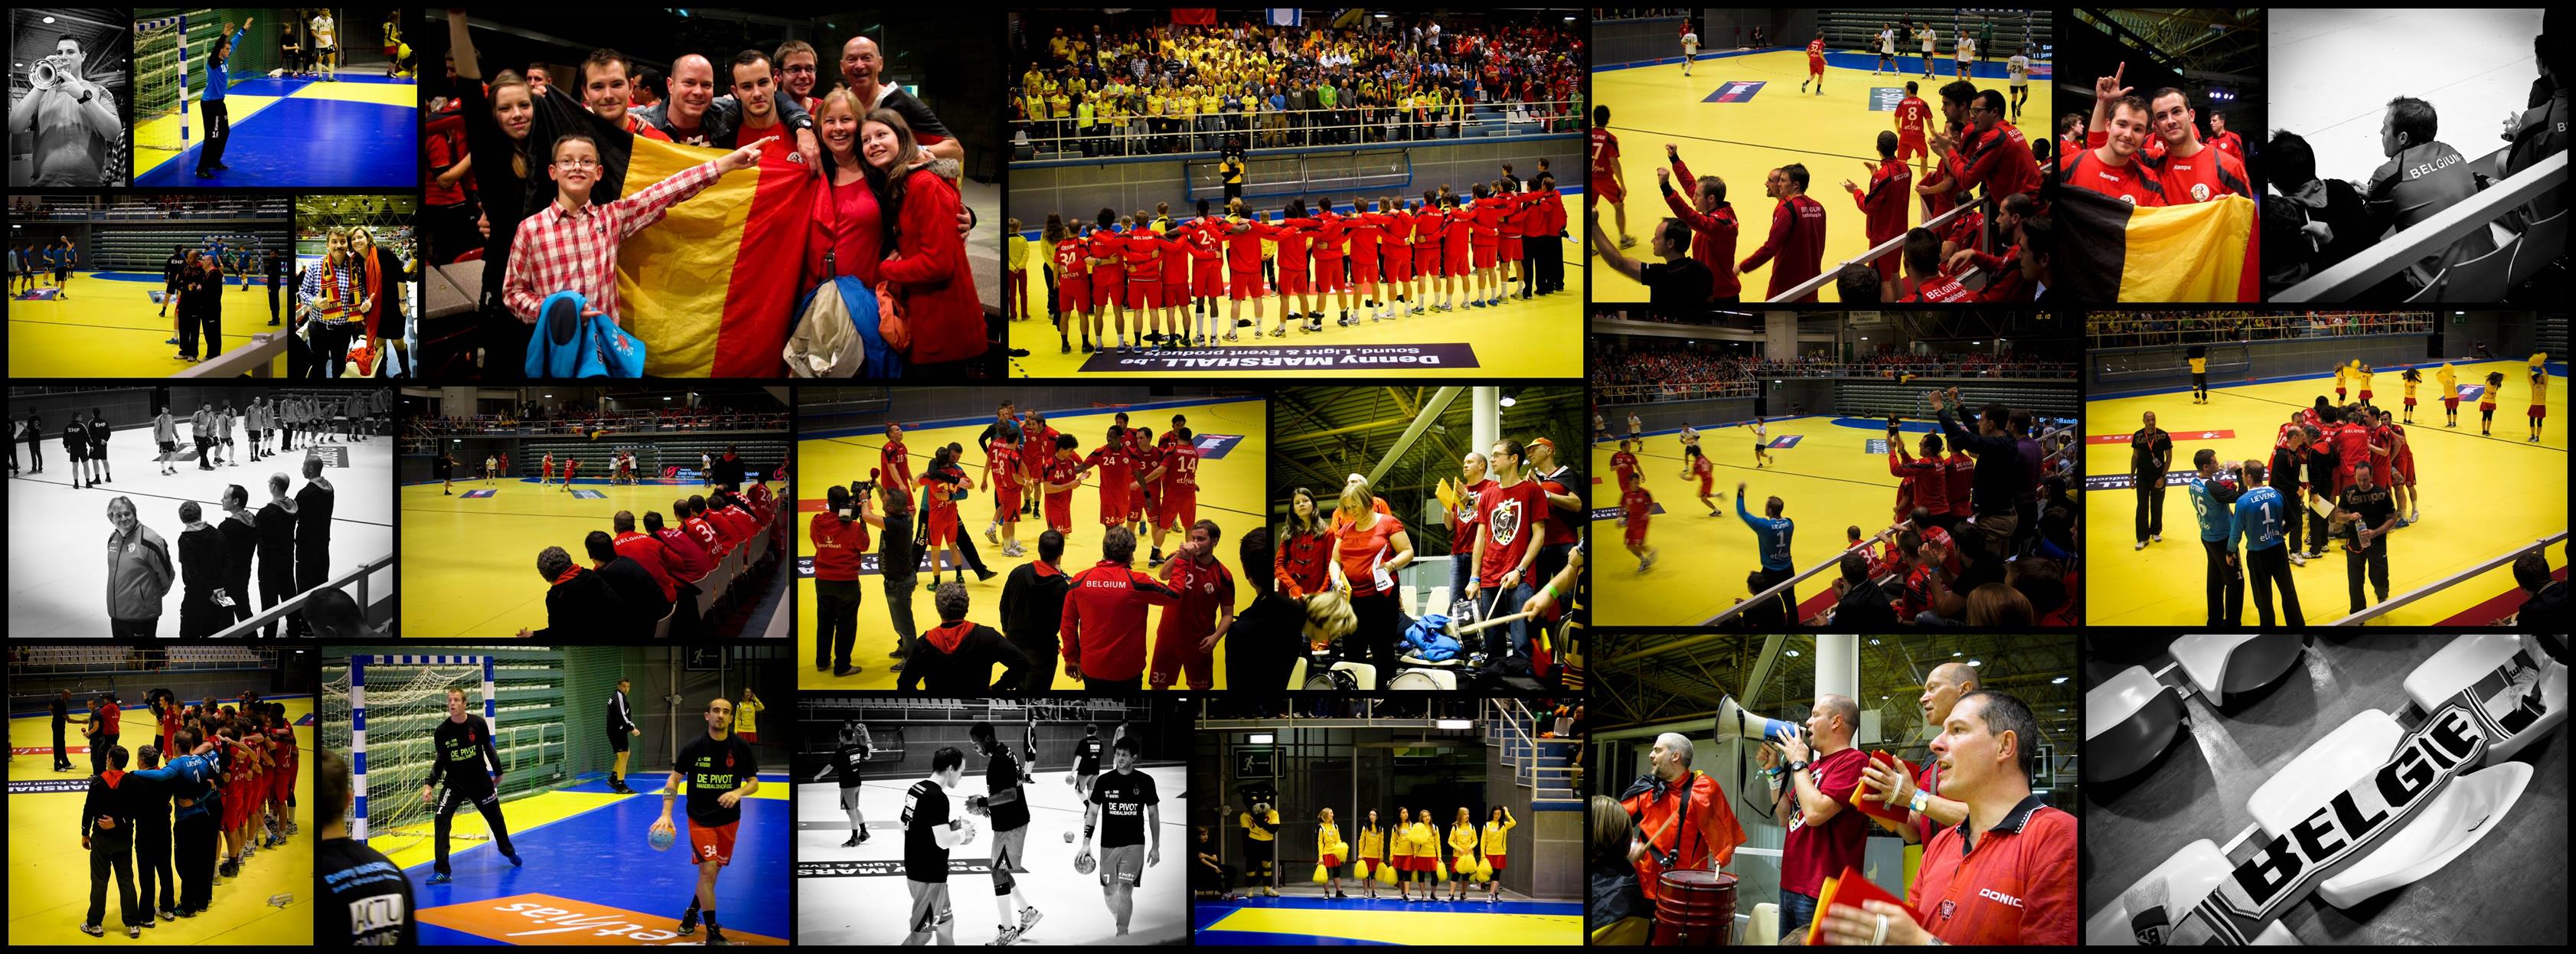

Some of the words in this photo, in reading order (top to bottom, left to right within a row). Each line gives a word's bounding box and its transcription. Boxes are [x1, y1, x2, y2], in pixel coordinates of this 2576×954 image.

[1908, 106, 1918, 121] 8
[2409, 153, 2462, 179] BELGIUM
[2099, 171, 2120, 181] Kempa
[1926, 279, 1962, 299] BELGIUM
[1161, 357, 1334, 367] MARSHALL
[1340, 355, 1440, 364] Denny
[1103, 456, 1116, 466] 24
[1177, 456, 1197, 473] 14
[1054, 470, 1065, 479] 44
[2251, 492, 2276, 503] LIEVENS
[2260, 502, 2275, 525] 1
[615, 534, 648, 546] BELGIUM
[1776, 530, 1787, 547] 1
[1859, 546, 1878, 564] 34
[1152, 671, 1167, 683] 32
[460, 745, 476, 755] PIVOT
[697, 773, 707, 783] DE
[710, 774, 733, 784] PIVOT
[439, 788, 452, 807] Kempa
[2231, 712, 2483, 907] BELGIE
[1979, 887, 2023, 909] DONIC
[354, 897, 403, 931] ACTU
